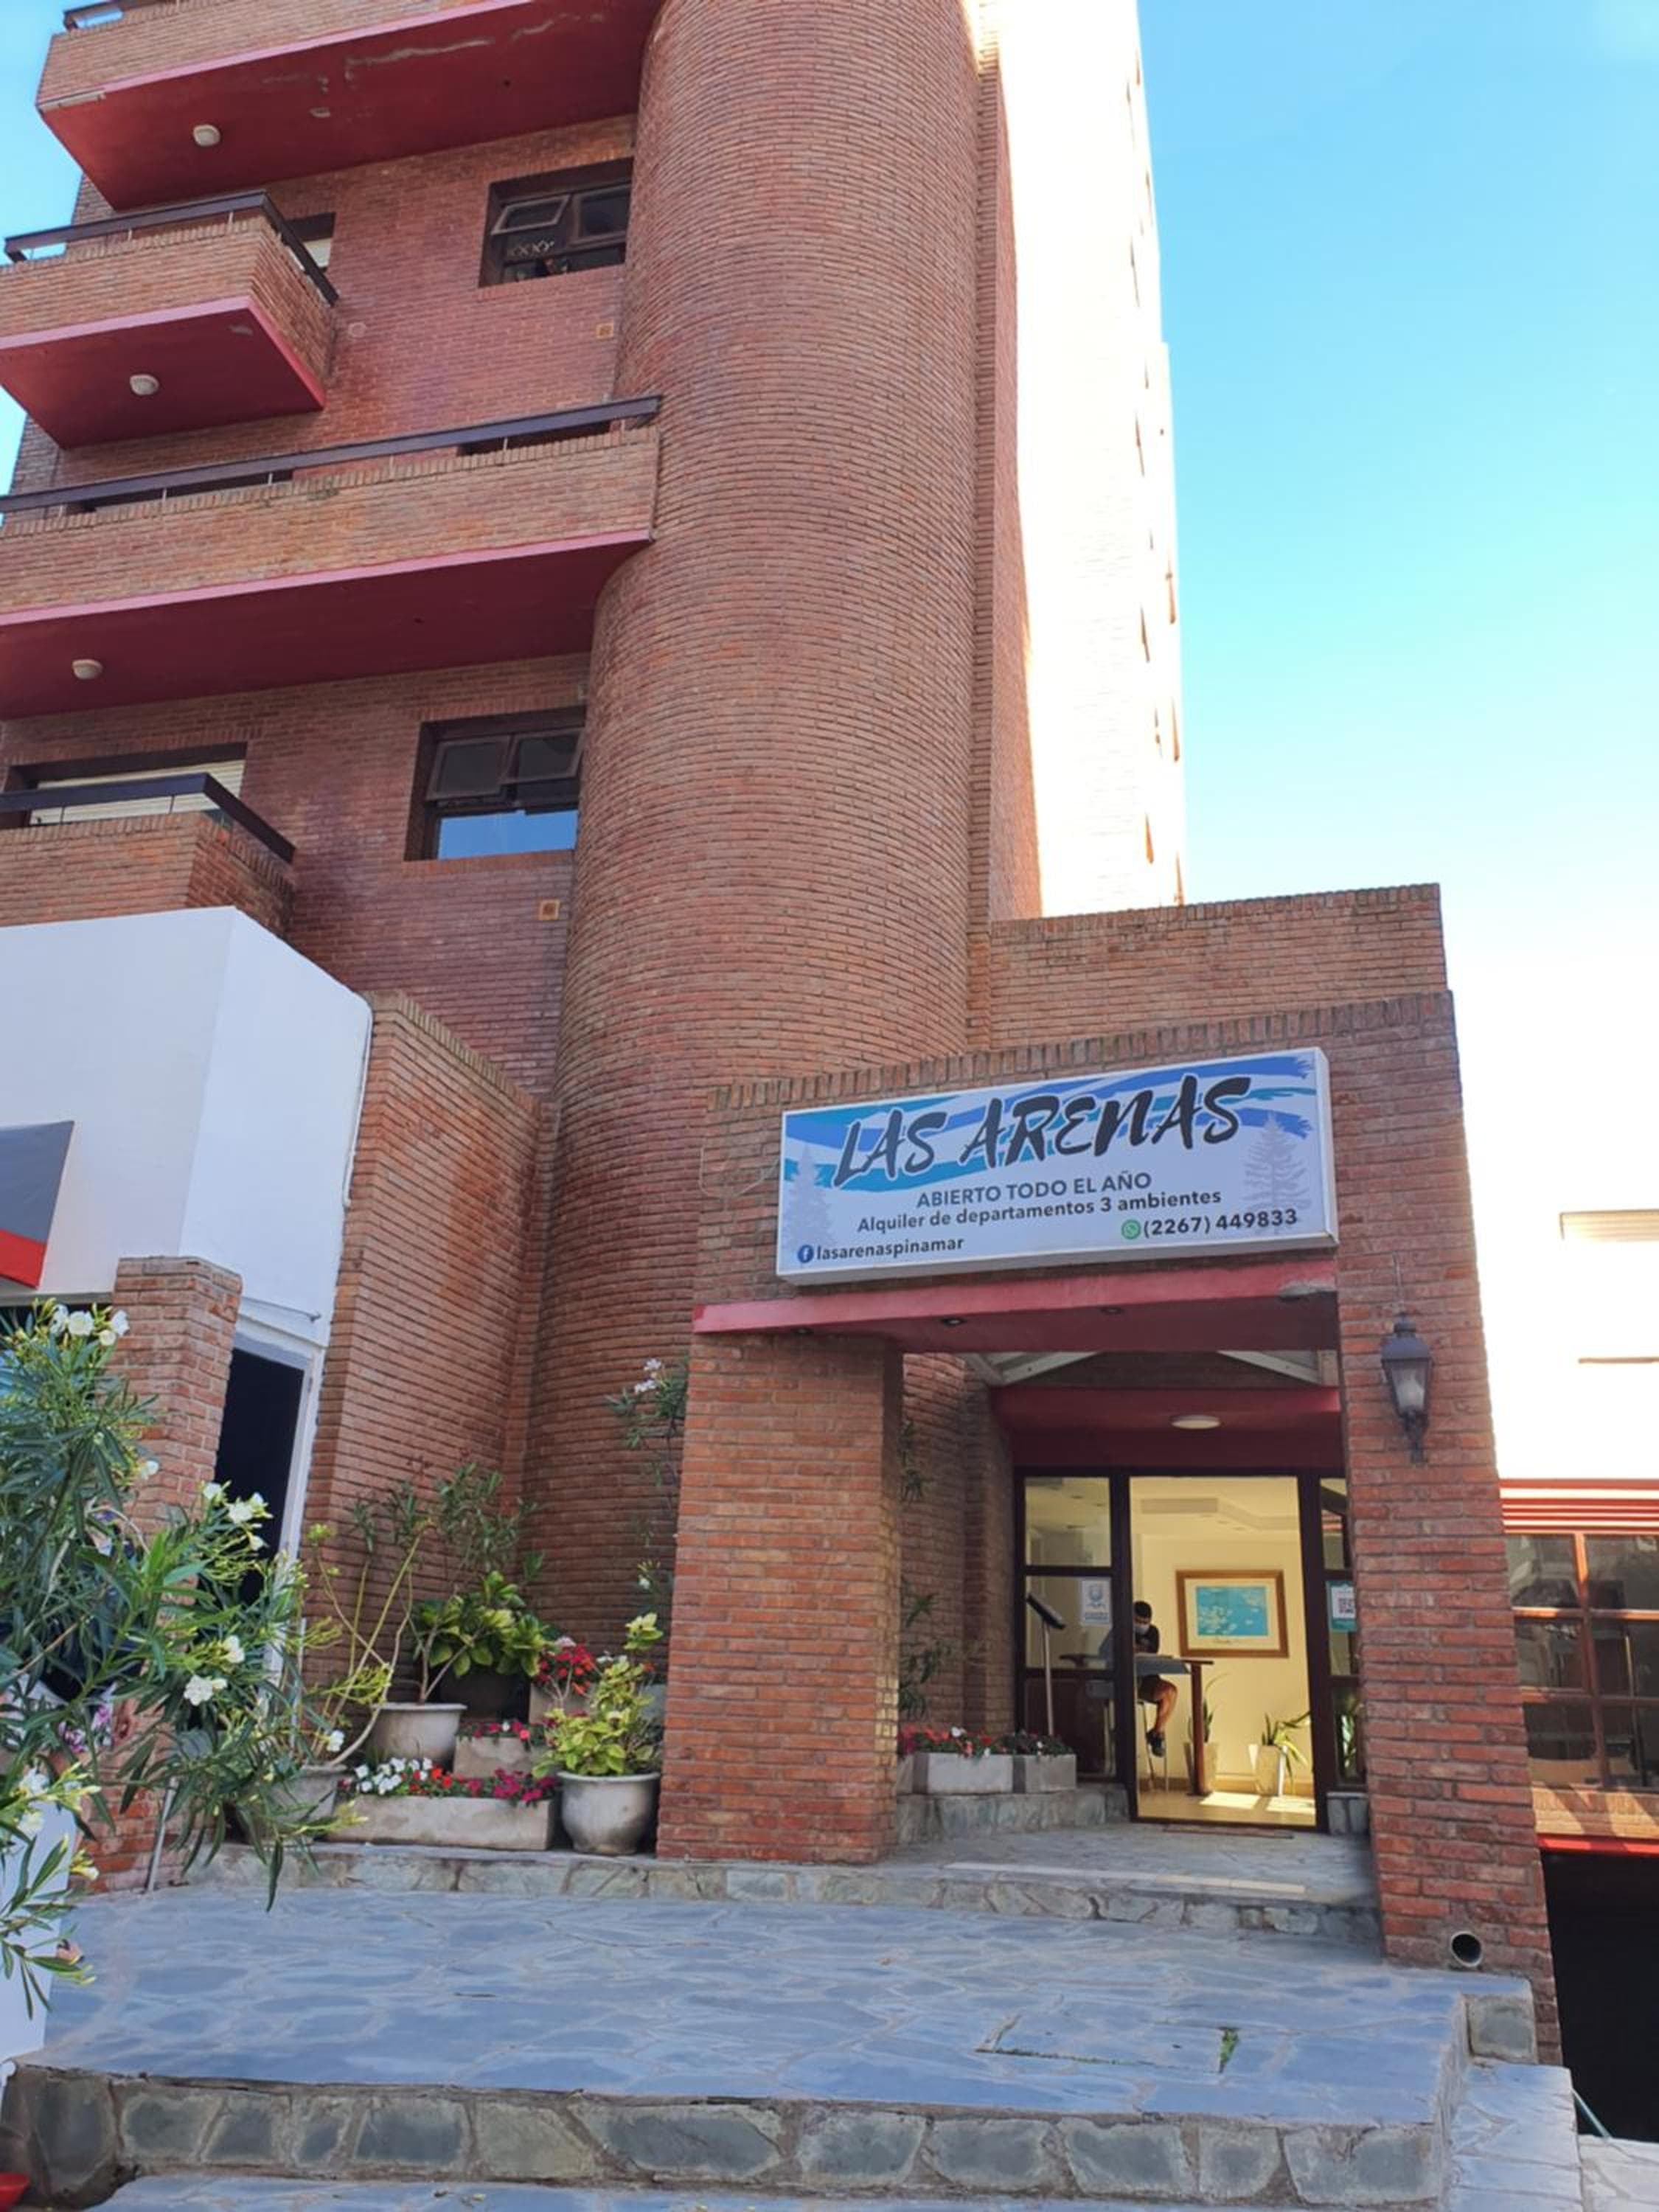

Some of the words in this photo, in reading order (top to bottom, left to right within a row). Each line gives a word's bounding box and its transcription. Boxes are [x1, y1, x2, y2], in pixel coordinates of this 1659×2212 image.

[832, 1108, 949, 1188] LAS
[959, 1074, 1253, 1169] ARENAS
[917, 1186, 1001, 1208] ABIERTO
[1006, 1180, 1067, 1200] TODO
[1074, 1178, 1097, 1194] EL
[1102, 1170, 1152, 1192] AÑO
[858, 1213, 926, 1234] Alquiler
[930, 1211, 951, 1227] de
[956, 1201, 1095, 1227] departamentos
[1100, 1197, 1111, 1213] 3
[1117, 1190, 1222, 1211] ambientes
[1143, 1216, 1211, 1239] (2267)
[1216, 1208, 1298, 1230] 449833
[816, 1236, 964, 1260] lasarenaspinamar
